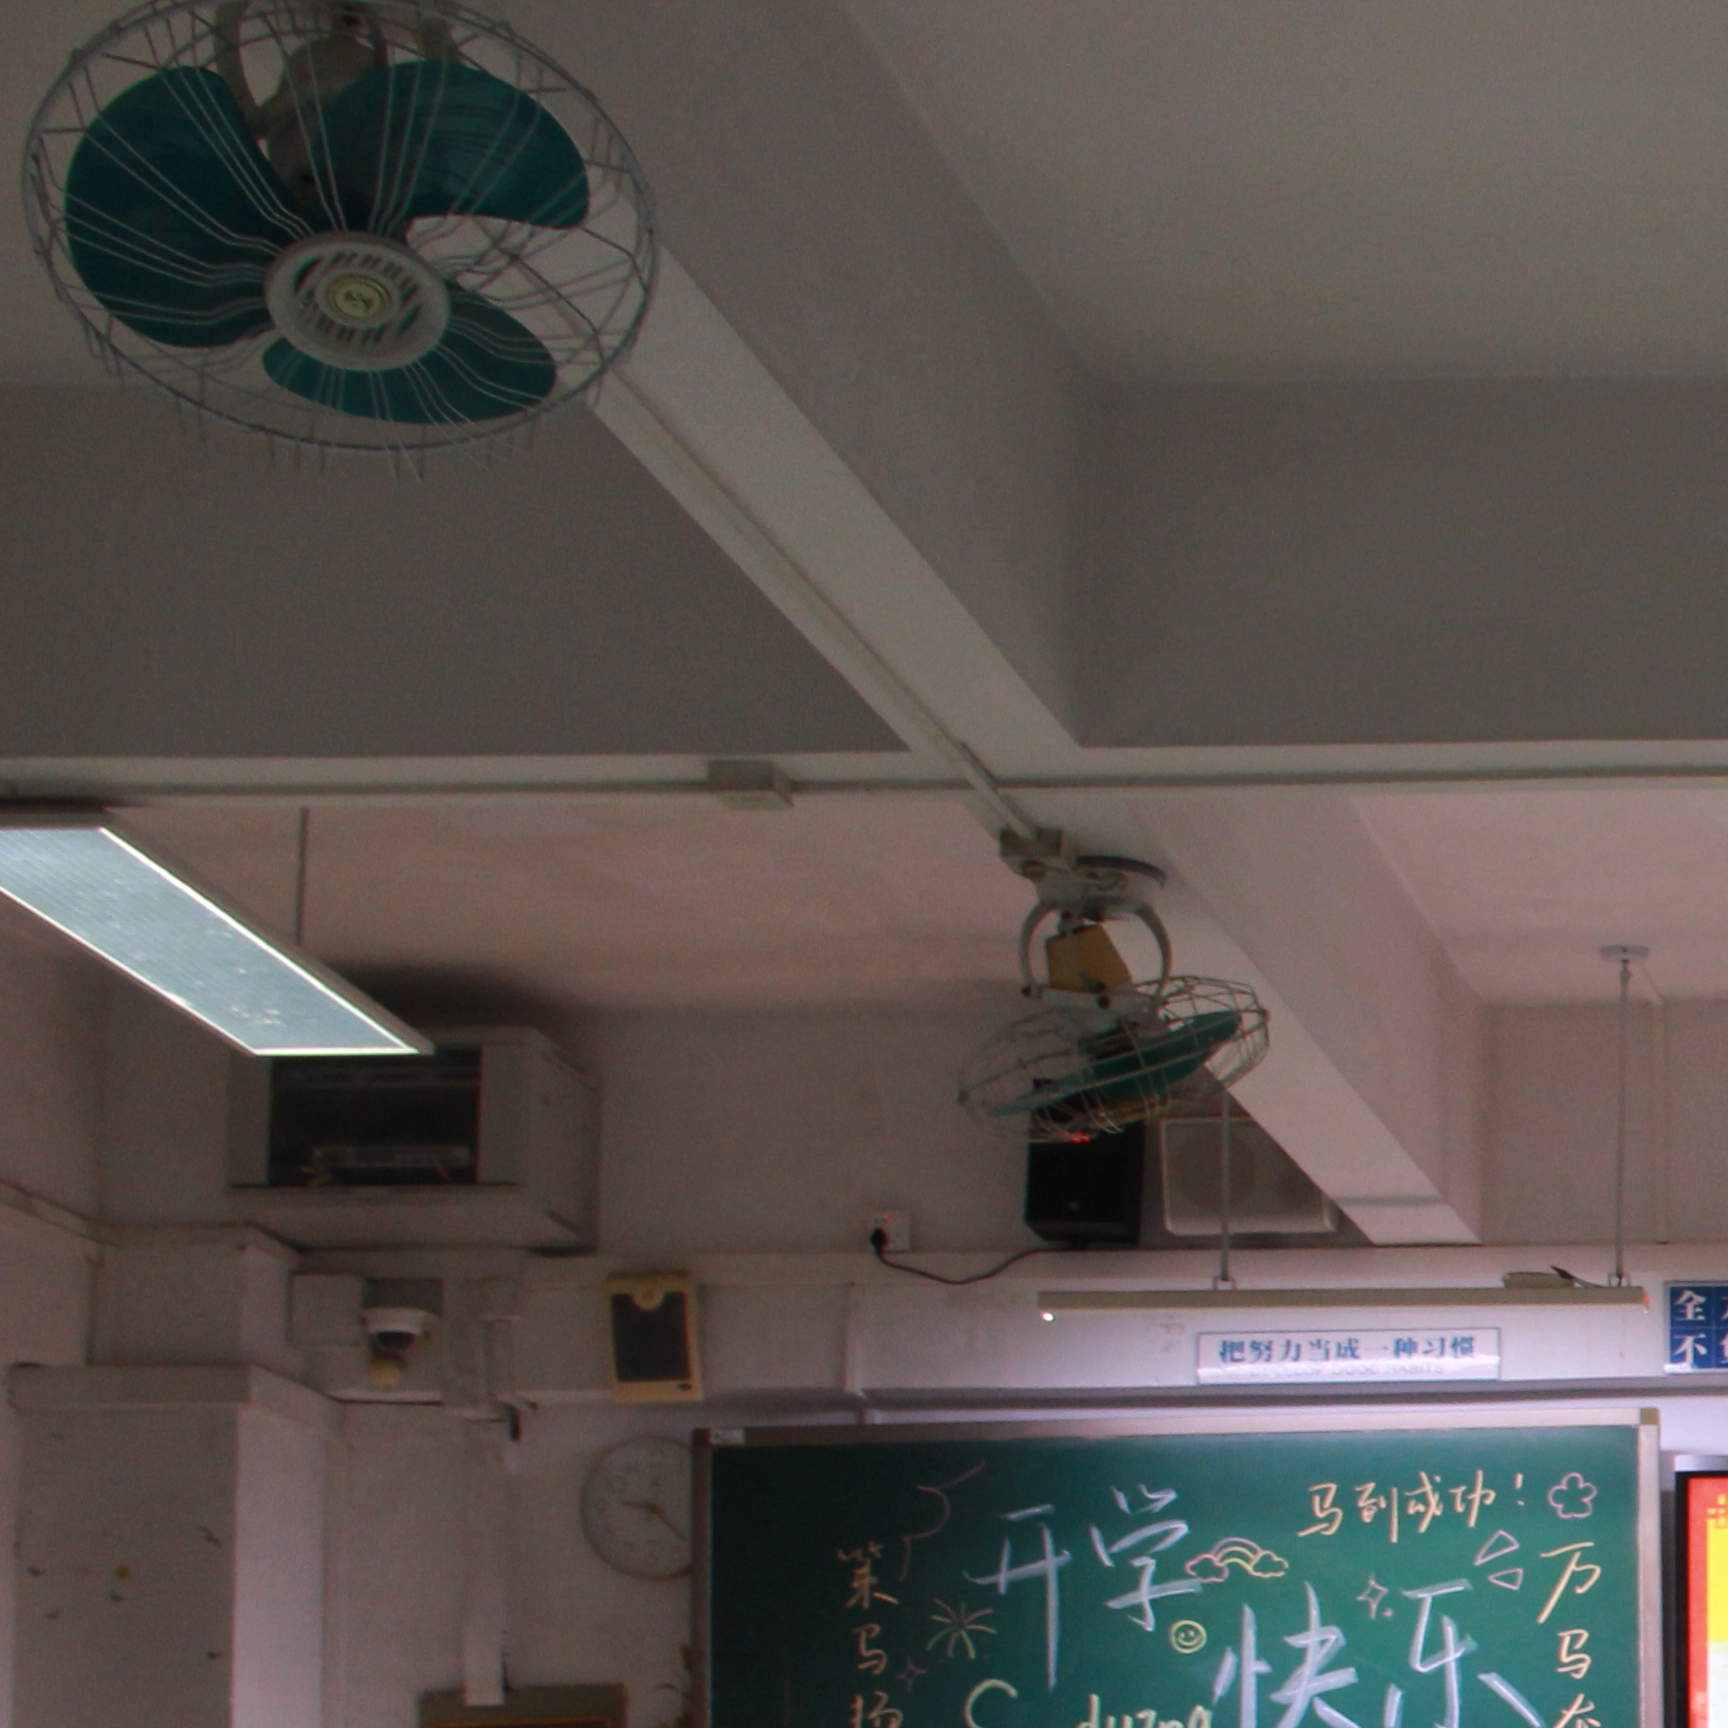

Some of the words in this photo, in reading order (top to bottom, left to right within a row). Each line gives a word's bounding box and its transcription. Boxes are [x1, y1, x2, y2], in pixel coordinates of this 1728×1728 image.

[1219, 1335, 1475, 1363] 把努力当成一种习惯
[964, 1483, 1202, 1692] 开学
